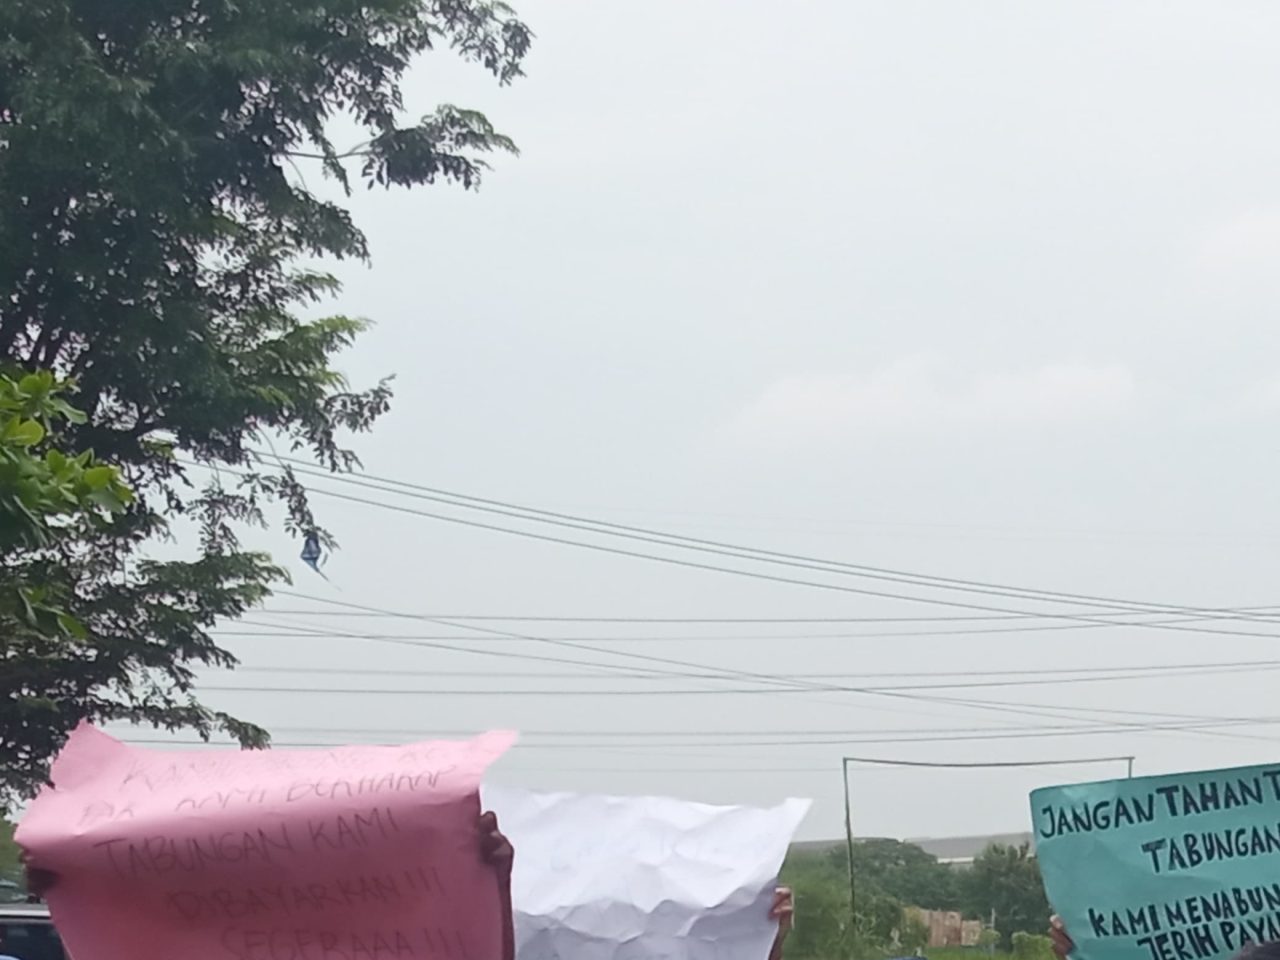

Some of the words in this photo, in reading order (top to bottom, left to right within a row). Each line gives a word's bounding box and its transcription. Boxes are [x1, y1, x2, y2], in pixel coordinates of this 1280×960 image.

[1040, 793, 1155, 839] JANGAN
[1156, 779, 1263, 823] TAHAN
[94, 821, 295, 880] TABUNGAN
[307, 806, 400, 848] KAMI
[1088, 907, 1160, 939] KAMI
